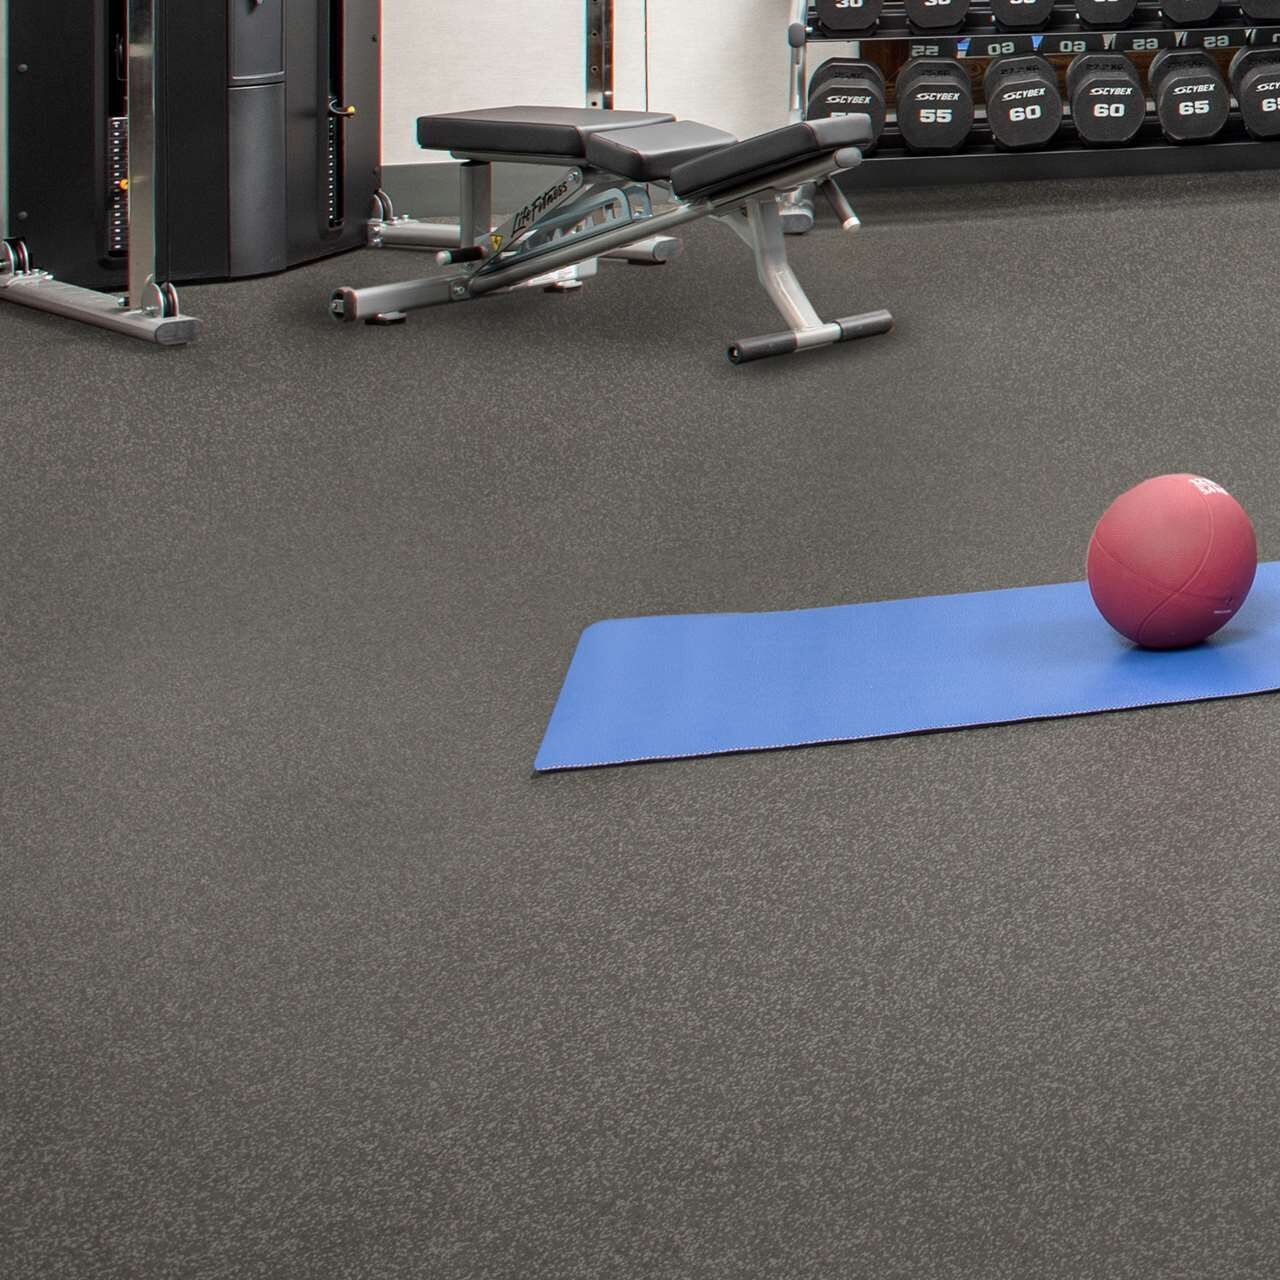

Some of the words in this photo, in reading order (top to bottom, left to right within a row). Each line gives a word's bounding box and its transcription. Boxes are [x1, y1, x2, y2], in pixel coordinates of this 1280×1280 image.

[1016, 88, 1045, 98] CYBEX
[1184, 83, 1214, 93] CYBEX
[840, 95, 872, 104] CYBEX
[929, 92, 960, 100] CYBEX
[1010, 105, 1041, 121] 60
[1094, 104, 1124, 116] 60
[1179, 100, 1209, 115] 65
[920, 109, 952, 122] 55
